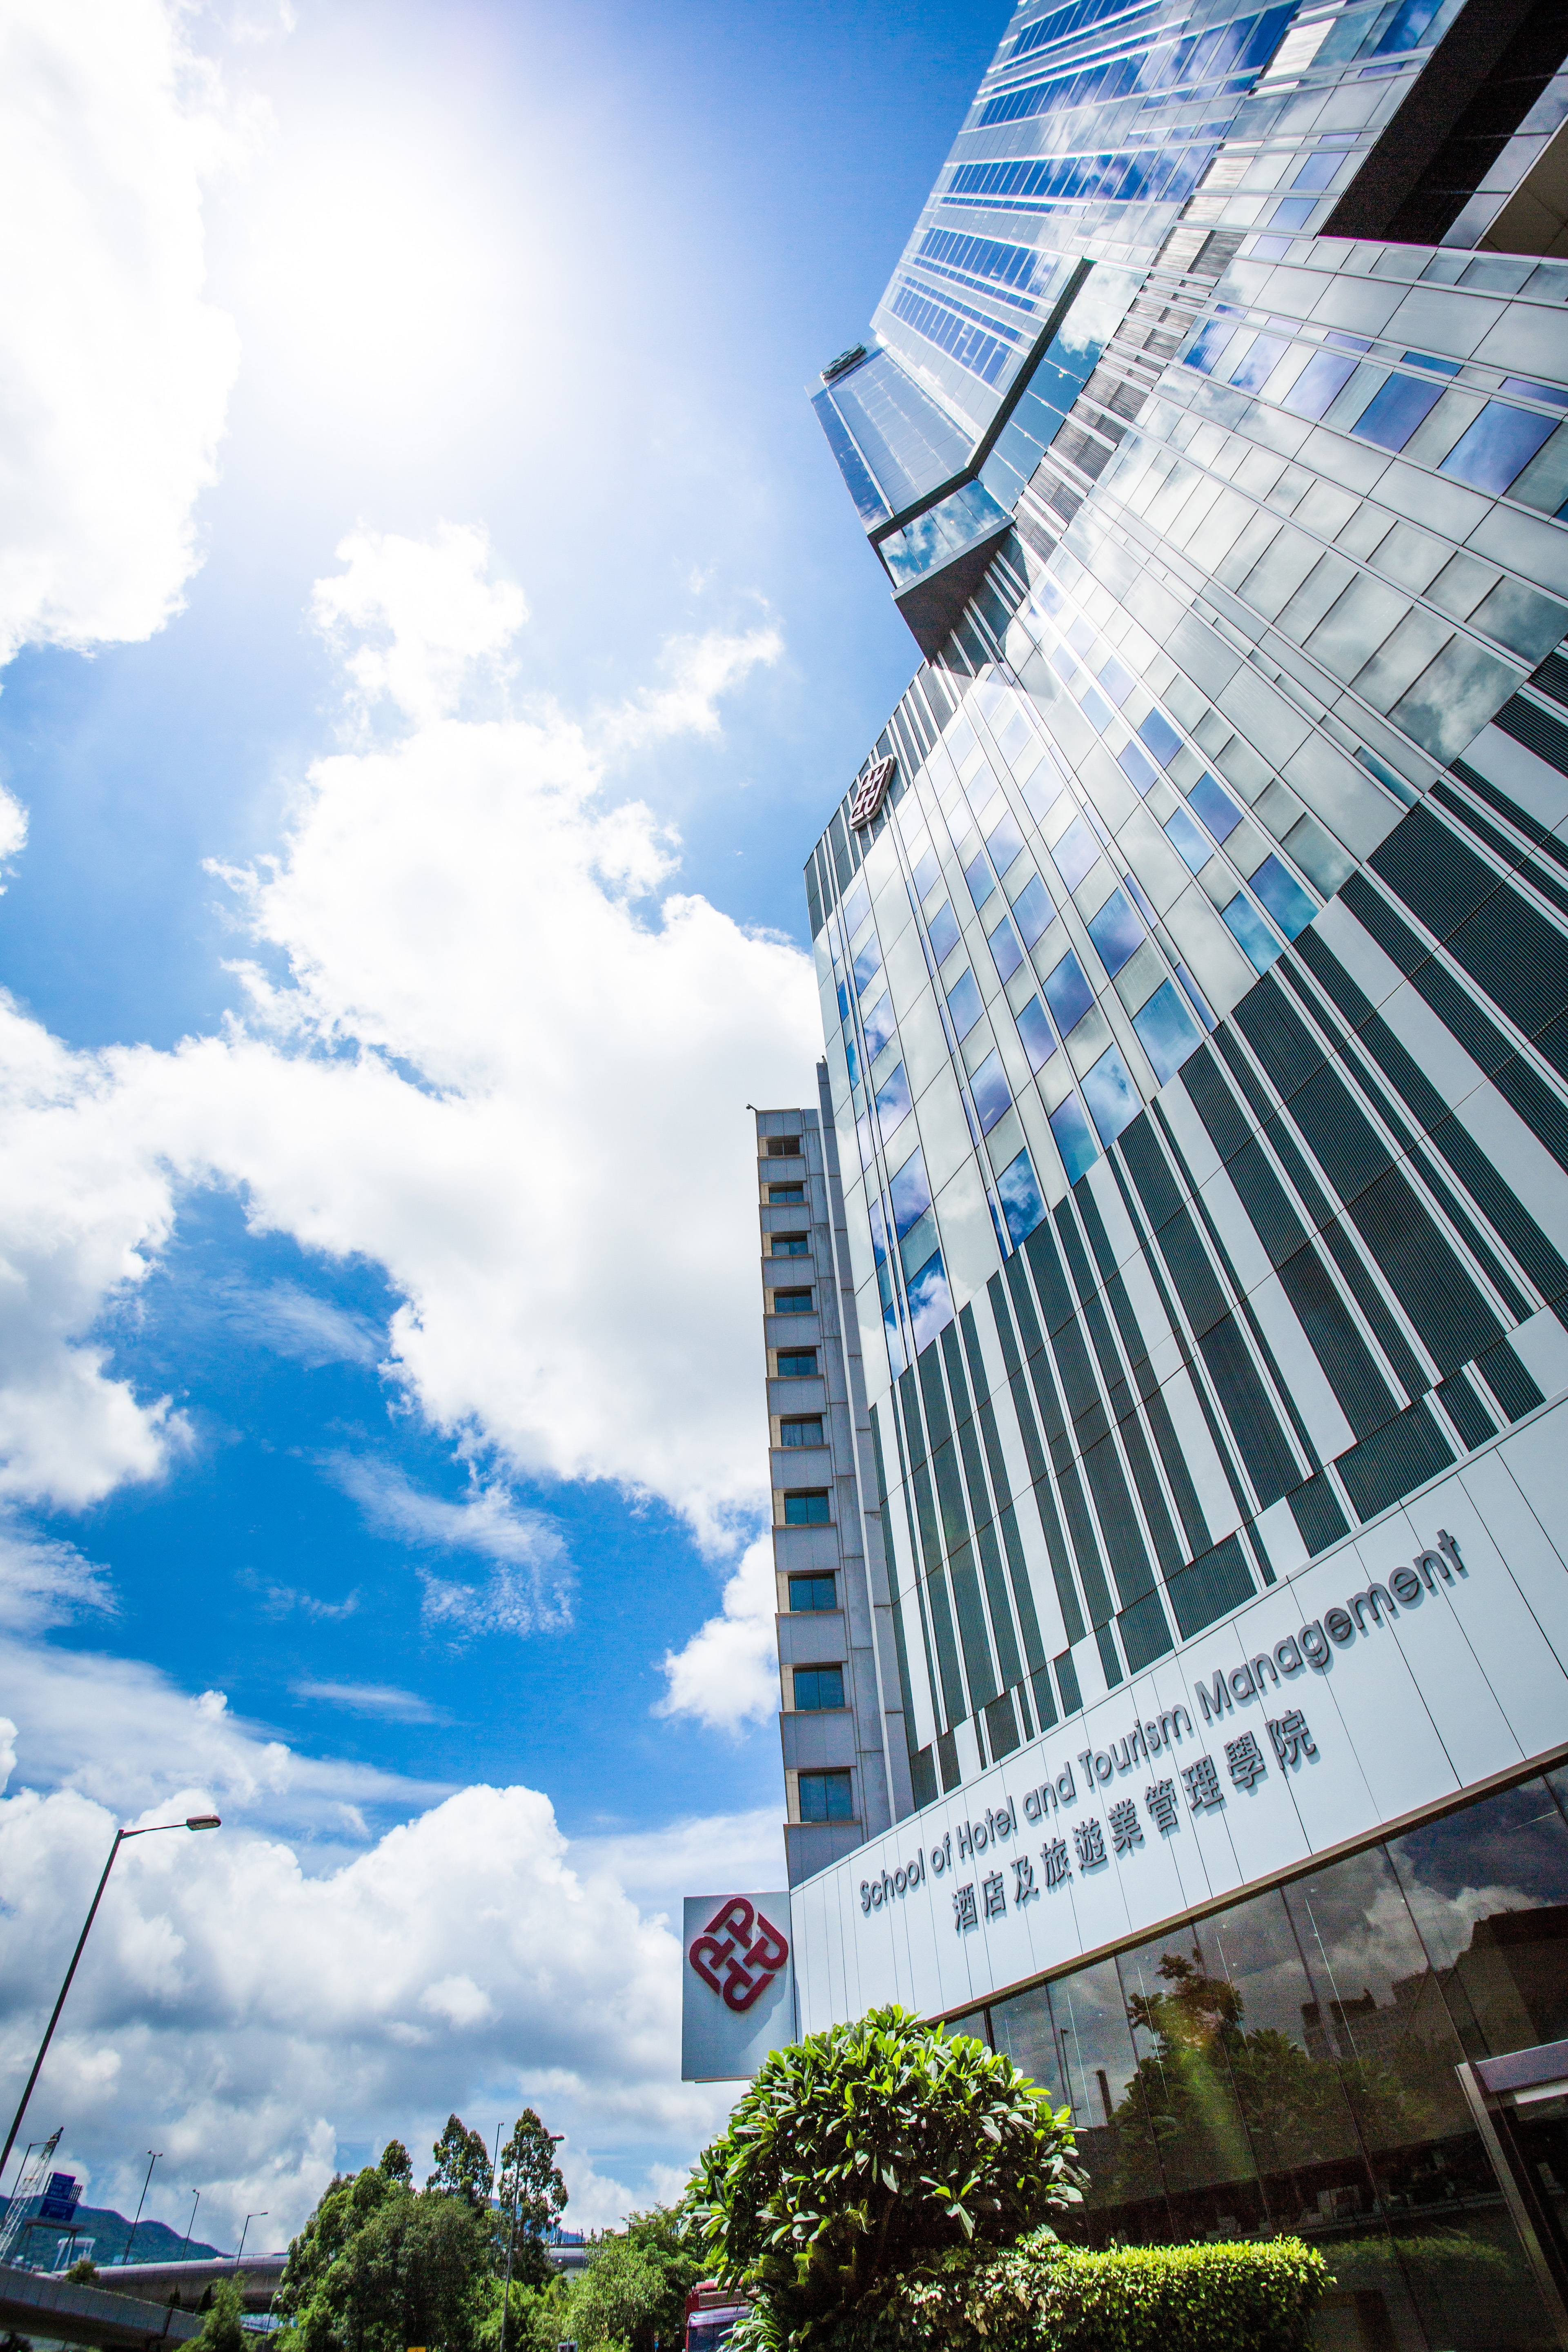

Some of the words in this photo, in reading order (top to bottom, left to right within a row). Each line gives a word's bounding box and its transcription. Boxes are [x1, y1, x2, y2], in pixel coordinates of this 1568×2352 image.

[860, 1848, 925, 1911] School
[930, 1831, 950, 1872] of
[956, 1795, 1017, 1858] Hotel
[1022, 1761, 1076, 1820] and
[1077, 1704, 1191, 1787] Tourism
[1194, 1528, 1463, 1720] Management
[951, 1709, 1316, 1931] 酒店及旅遊業管理學院
